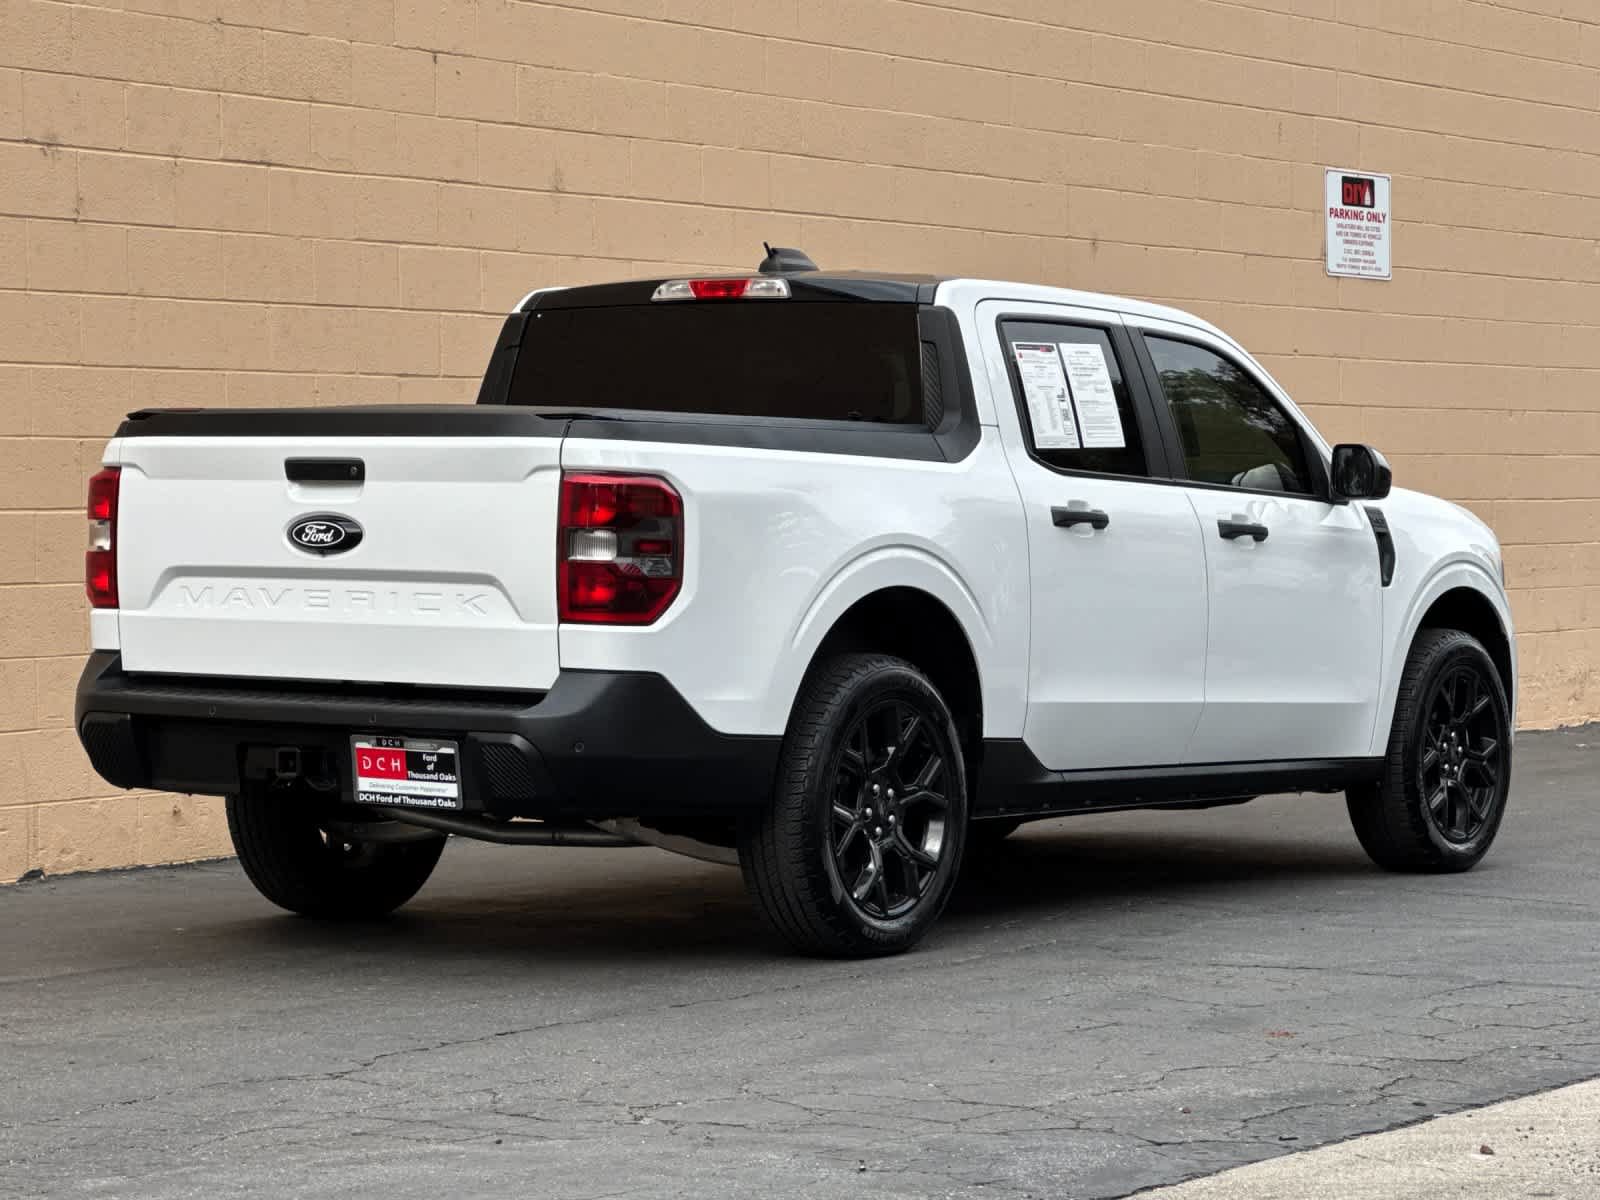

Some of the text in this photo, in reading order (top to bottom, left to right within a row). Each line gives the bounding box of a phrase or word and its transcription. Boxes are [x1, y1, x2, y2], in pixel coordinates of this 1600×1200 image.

[1329, 207, 1387, 224] PARKING ONLY
[301, 524, 335, 543] Ford
[176, 583, 491, 616] MAVERICK
[422, 753, 437, 762] Ford
[426, 763, 435, 771] of
[407, 771, 457, 782] Thousand Oaks
[359, 792, 457, 808] DCH Ford of Thousand Oaks
